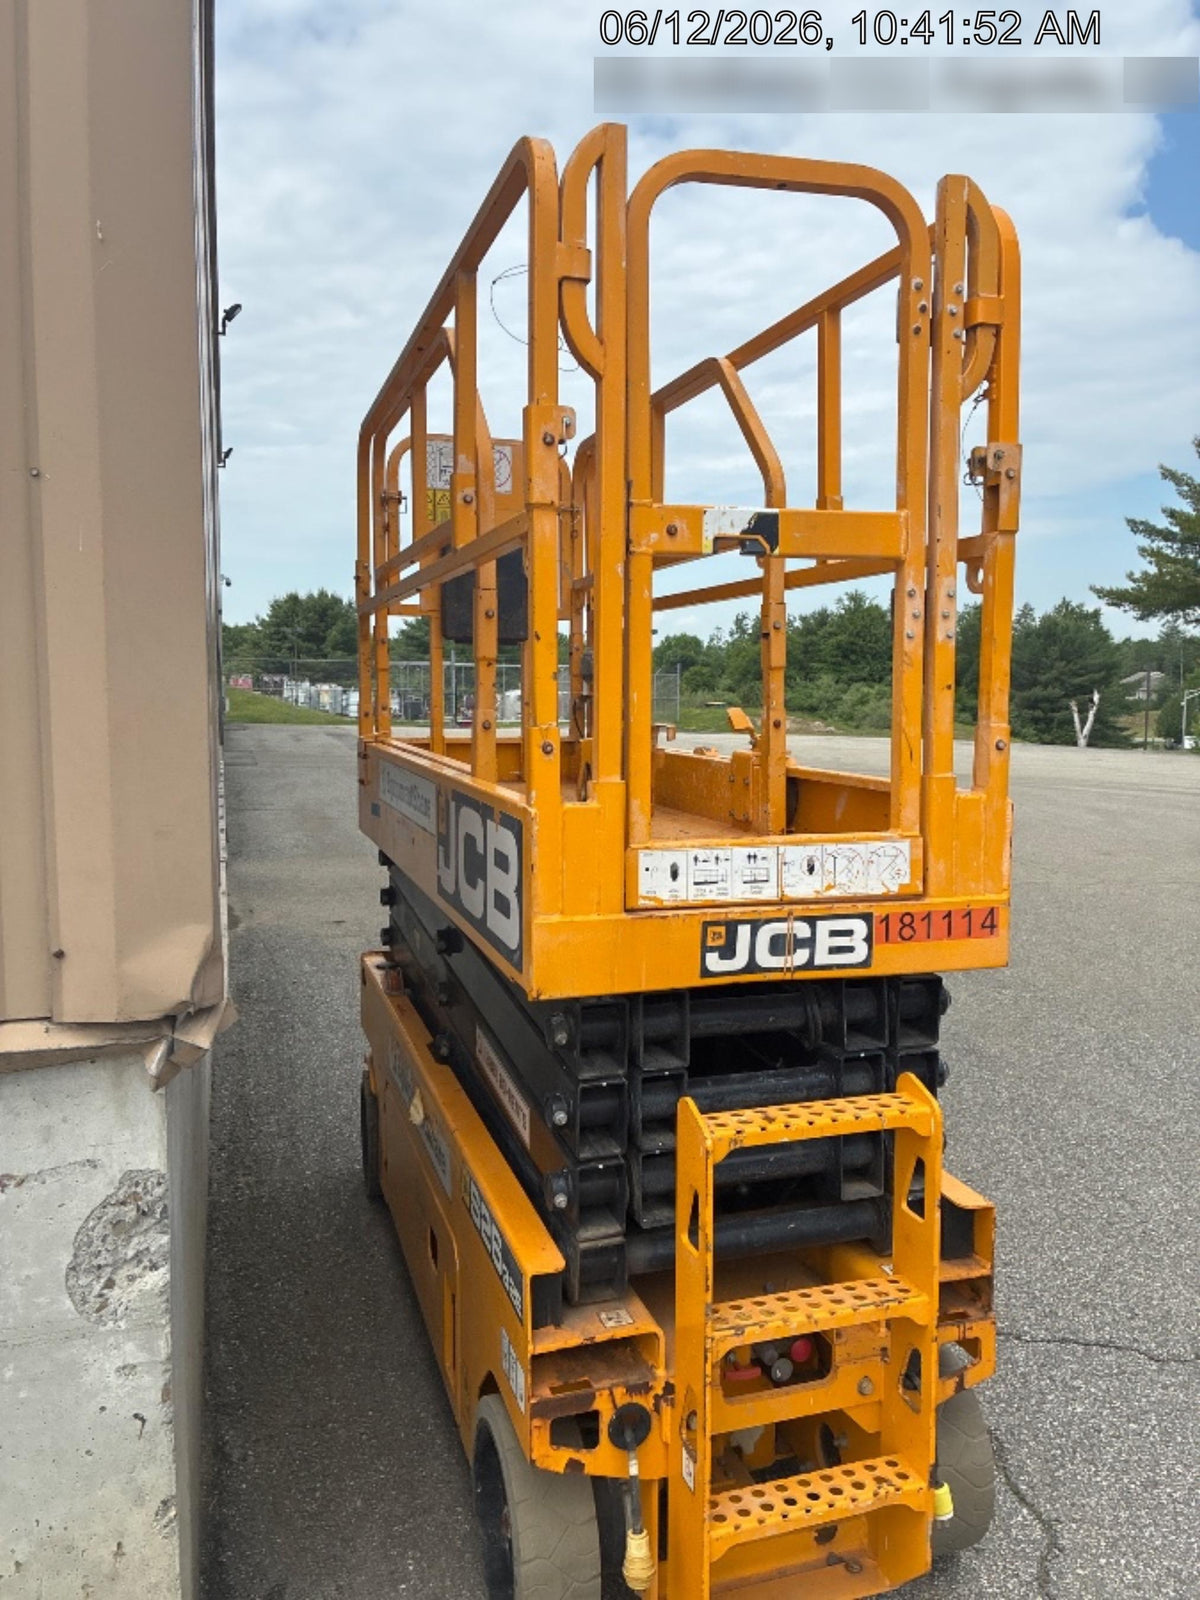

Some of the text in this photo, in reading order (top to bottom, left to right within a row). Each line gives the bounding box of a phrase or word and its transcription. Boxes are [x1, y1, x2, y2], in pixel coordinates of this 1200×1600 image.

[438, 799, 520, 950] JCB
[705, 919, 869, 972] JCB
[879, 907, 998, 942] 181114
